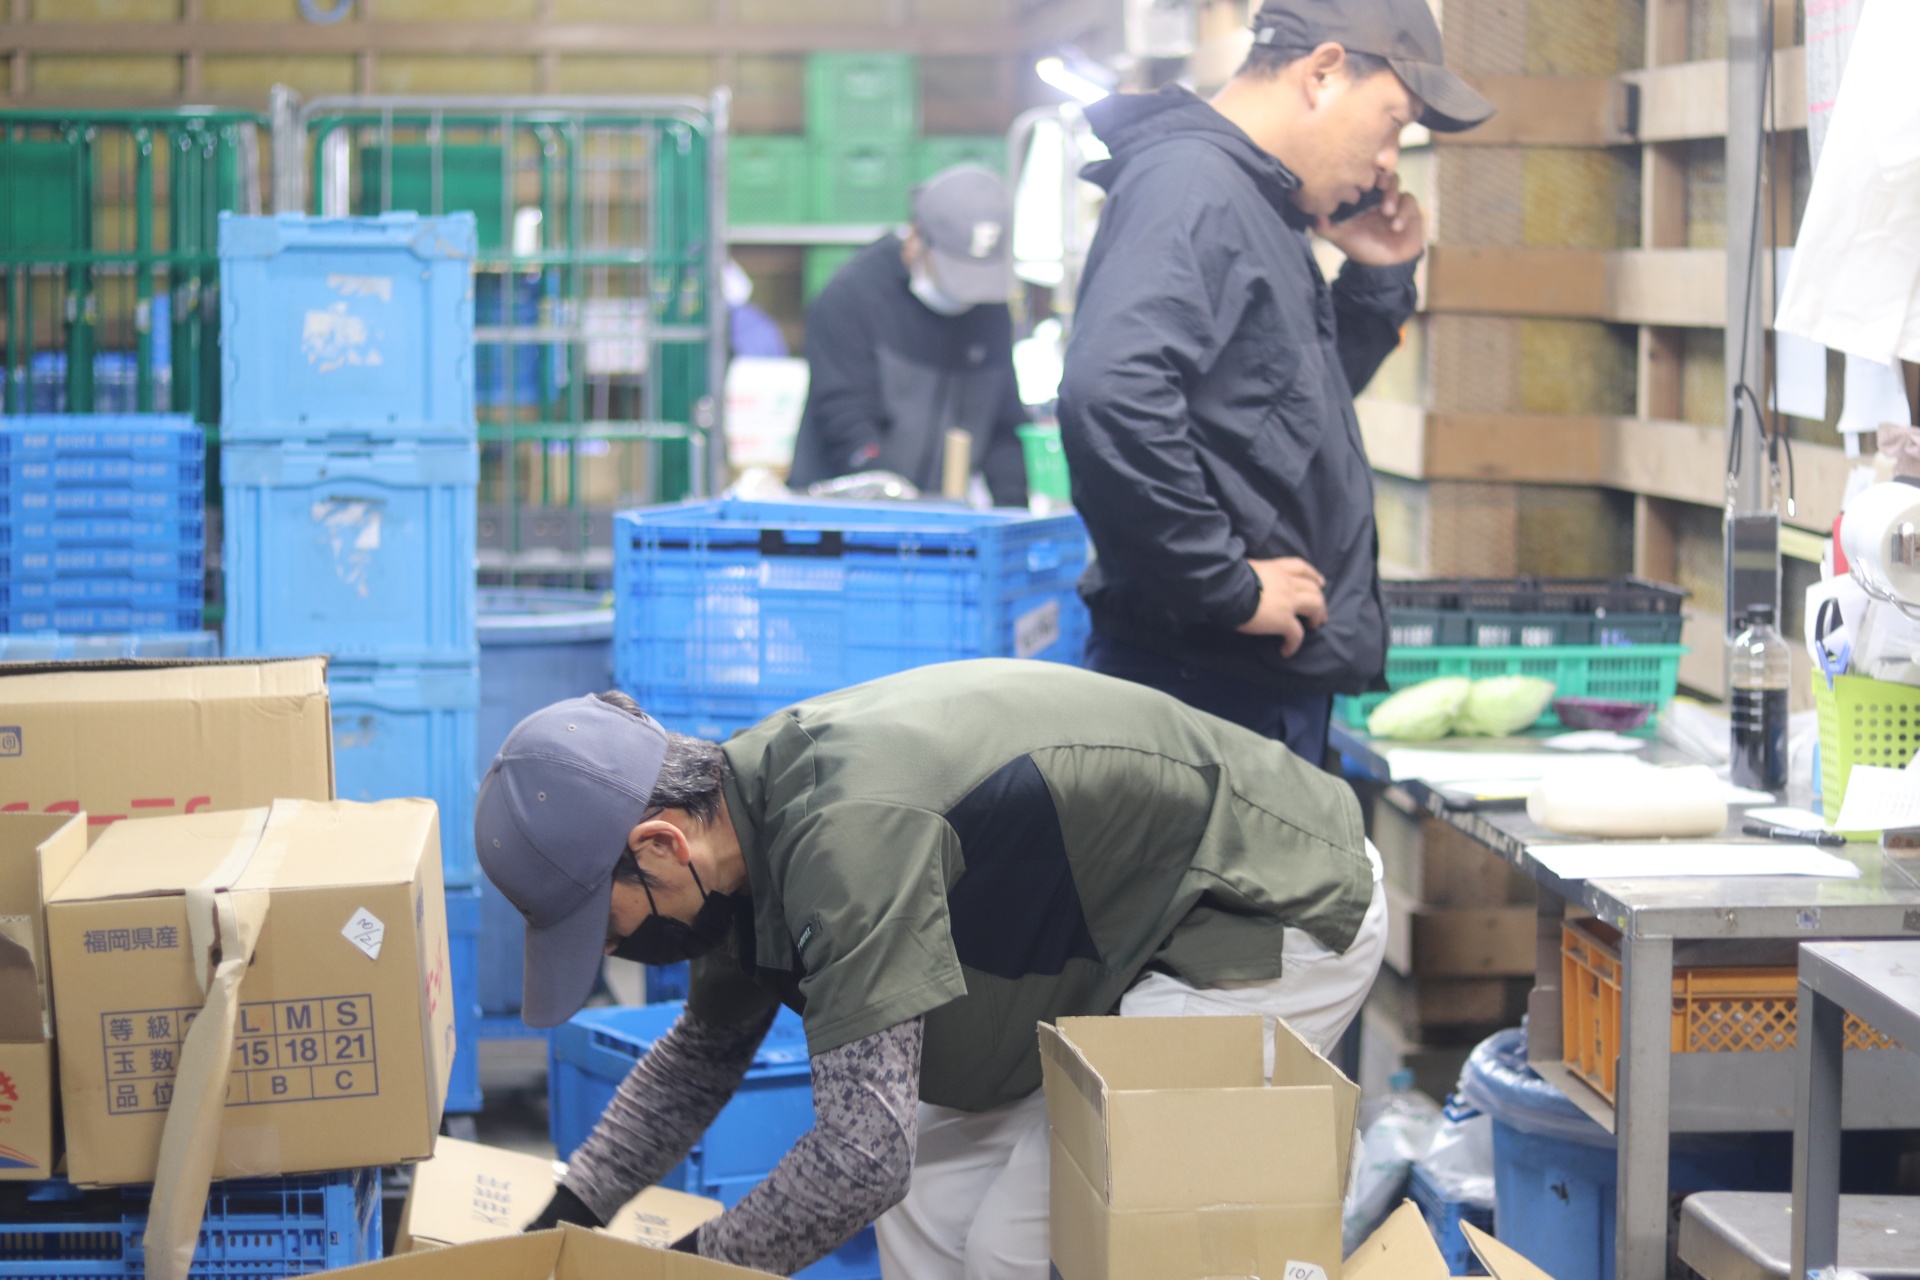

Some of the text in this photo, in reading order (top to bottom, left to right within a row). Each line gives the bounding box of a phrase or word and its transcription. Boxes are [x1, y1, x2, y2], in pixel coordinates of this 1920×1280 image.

[83, 926, 179, 953] 福岡県産
[240, 1009, 260, 1033] L
[286, 1004, 312, 1029] M
[336, 1001, 358, 1026] S
[237, 1040, 269, 1066] 15
[285, 1037, 318, 1063] 18
[335, 1034, 366, 1060] 21
[271, 1075, 288, 1095] B
[335, 1070, 353, 1090] C
